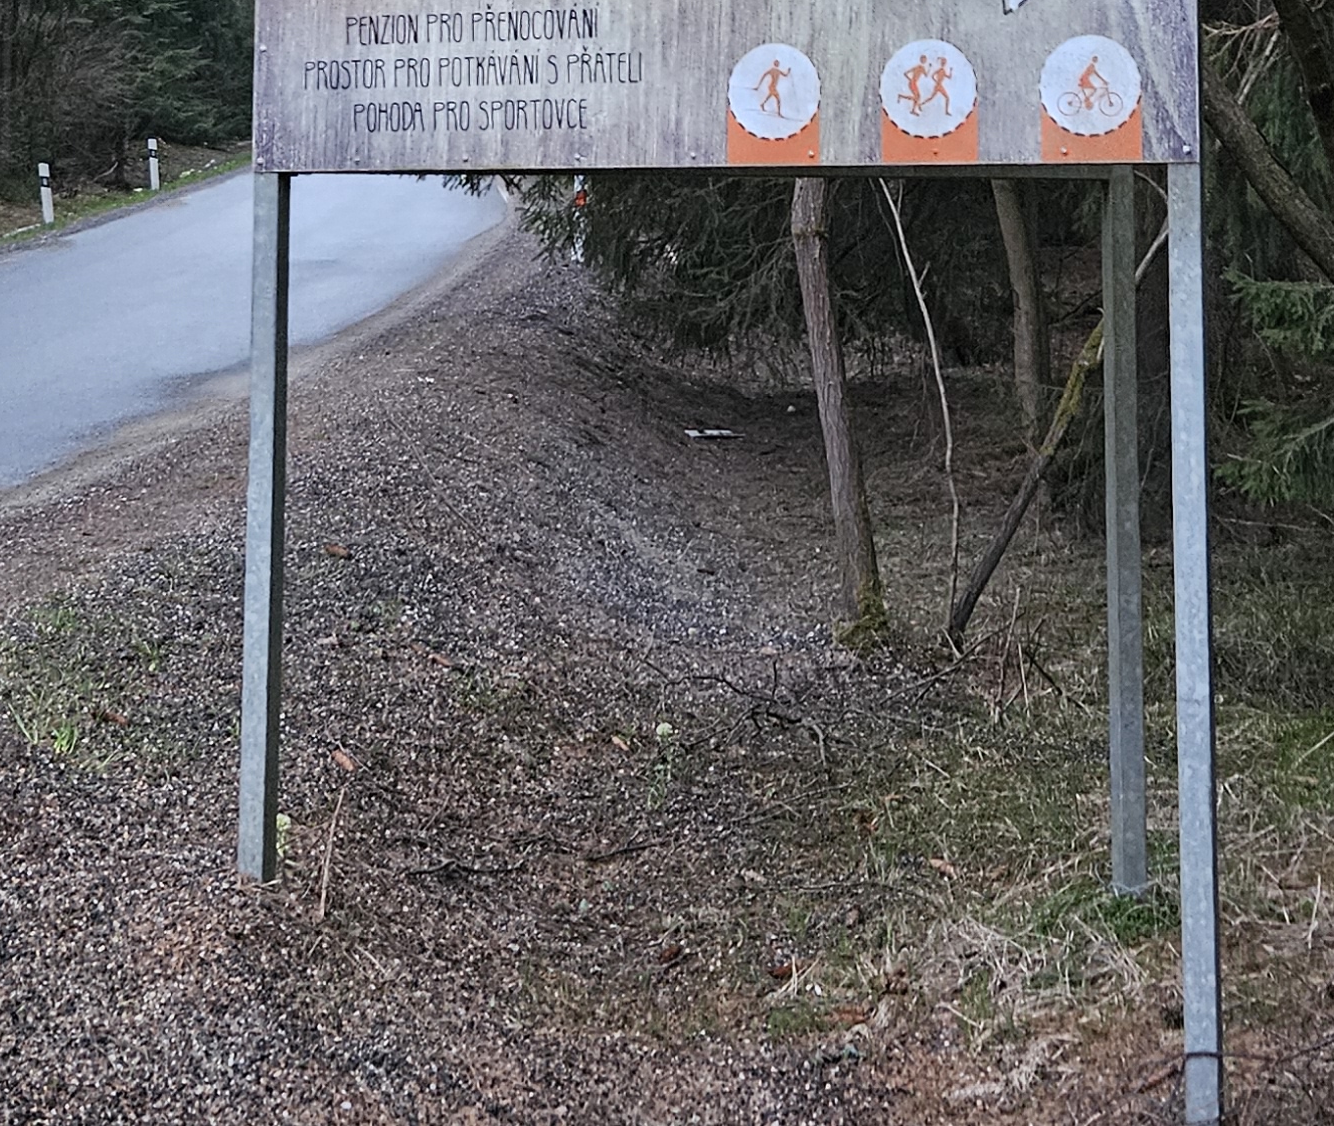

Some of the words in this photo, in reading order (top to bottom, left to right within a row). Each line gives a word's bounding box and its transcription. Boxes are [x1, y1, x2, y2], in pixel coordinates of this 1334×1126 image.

[346, 14, 418, 45] PENZION
[427, 12, 463, 43] PRO
[472, 3, 599, 42] PŘENOCOVÁNÍ
[304, 59, 385, 90] PROSTOR
[394, 57, 430, 88] PRO
[438, 48, 540, 88] POTKÁVÁNÍ
[547, 54, 559, 85] S
[567, 45, 643, 83] PŘÁTELI
[353, 102, 425, 133] POHODA
[433, 101, 470, 132] PRO
[478, 98, 588, 131] SPORTOVCE
